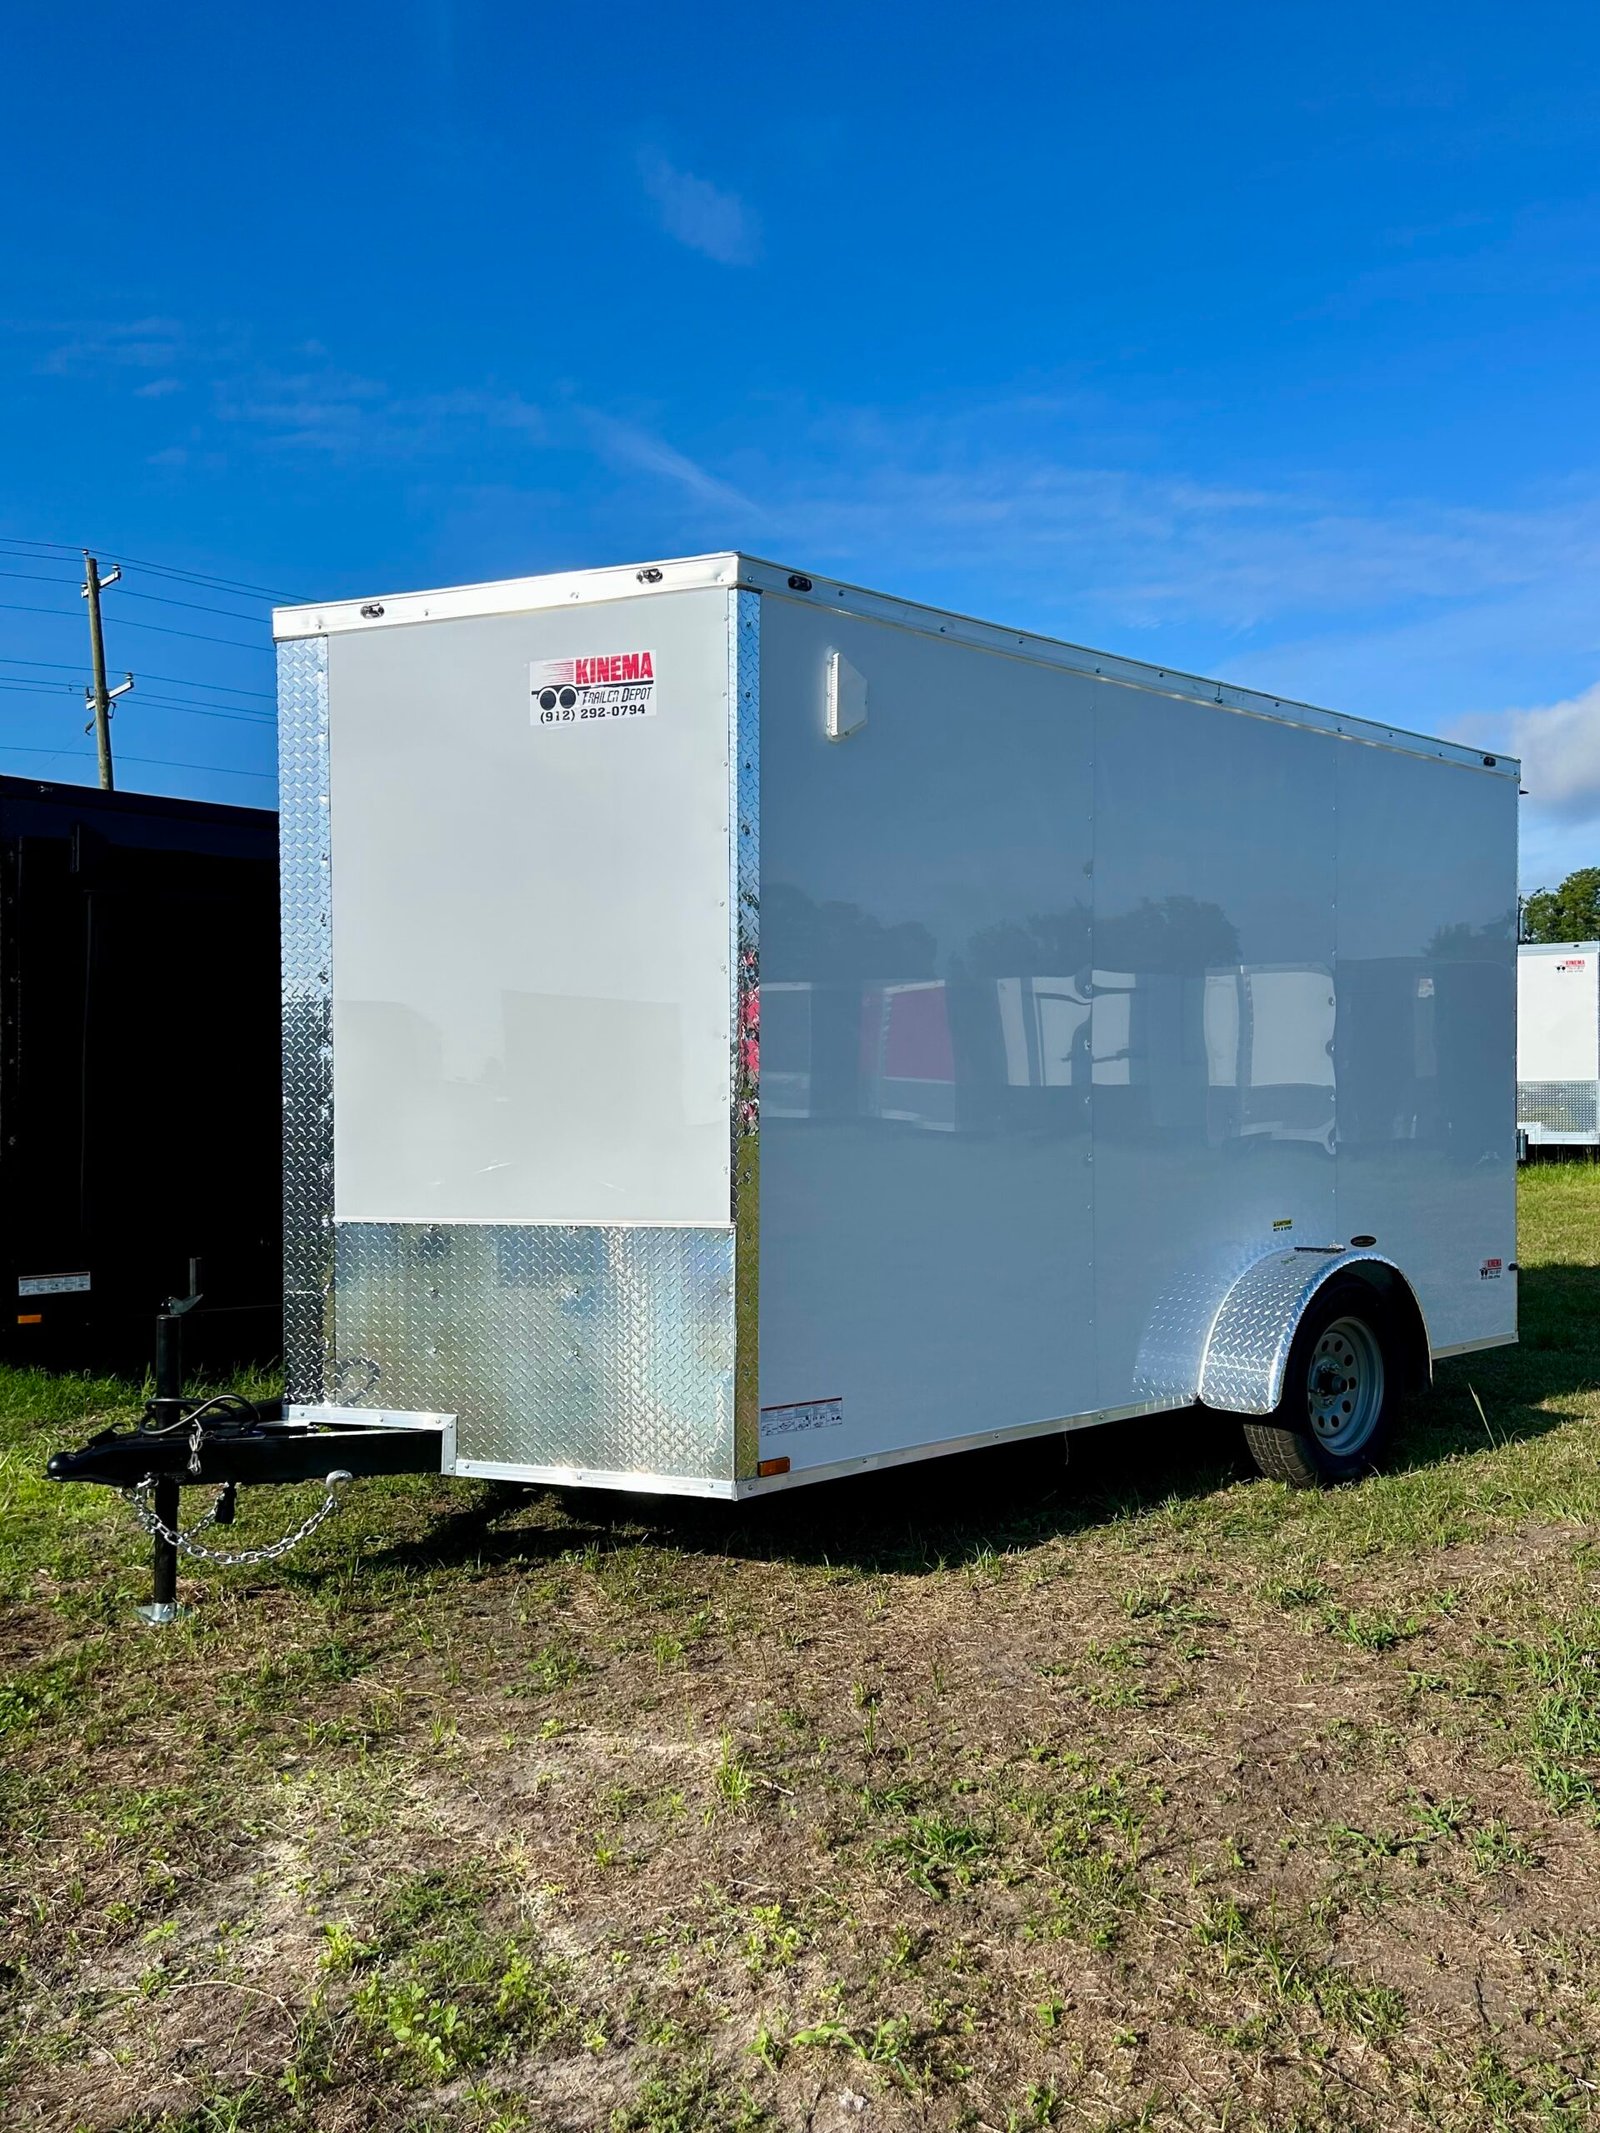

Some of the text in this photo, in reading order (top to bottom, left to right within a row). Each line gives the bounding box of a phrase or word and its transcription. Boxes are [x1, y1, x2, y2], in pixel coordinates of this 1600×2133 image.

[575, 651, 654, 685] KINEMA
[621, 686, 653, 703] DEPOT
[540, 703, 646, 724] (912) 292-0794
